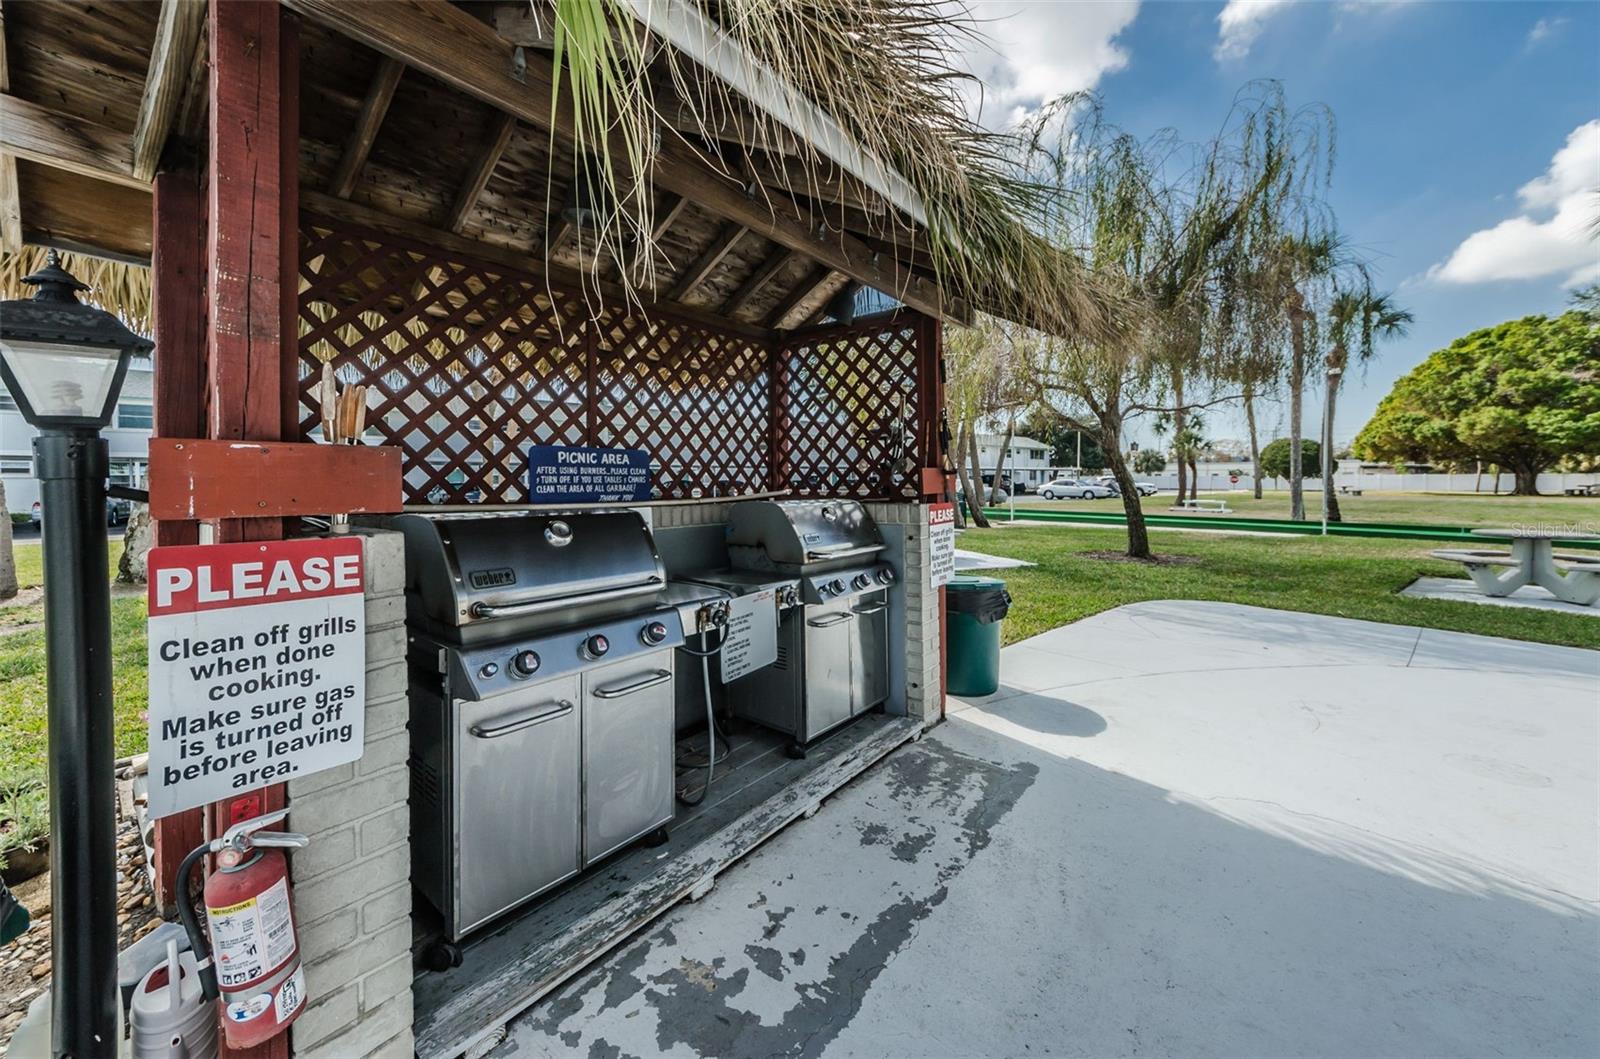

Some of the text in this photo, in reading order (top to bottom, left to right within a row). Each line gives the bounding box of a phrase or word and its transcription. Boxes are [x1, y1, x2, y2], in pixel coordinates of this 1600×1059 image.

[558, 451, 629, 464] PICNIC AREA
[930, 509, 954, 523] PLEASE
[156, 555, 360, 607] PLEASE
[474, 571, 503, 586] weber
[160, 616, 356, 662] Clean off grills
[190, 644, 335, 680] when done
[208, 668, 321, 700] cooking.
[162, 684, 355, 740] Make sure gas
[180, 703, 343, 759] is turned off
[164, 724, 352, 786] before leaving
[232, 760, 299, 788] area.
